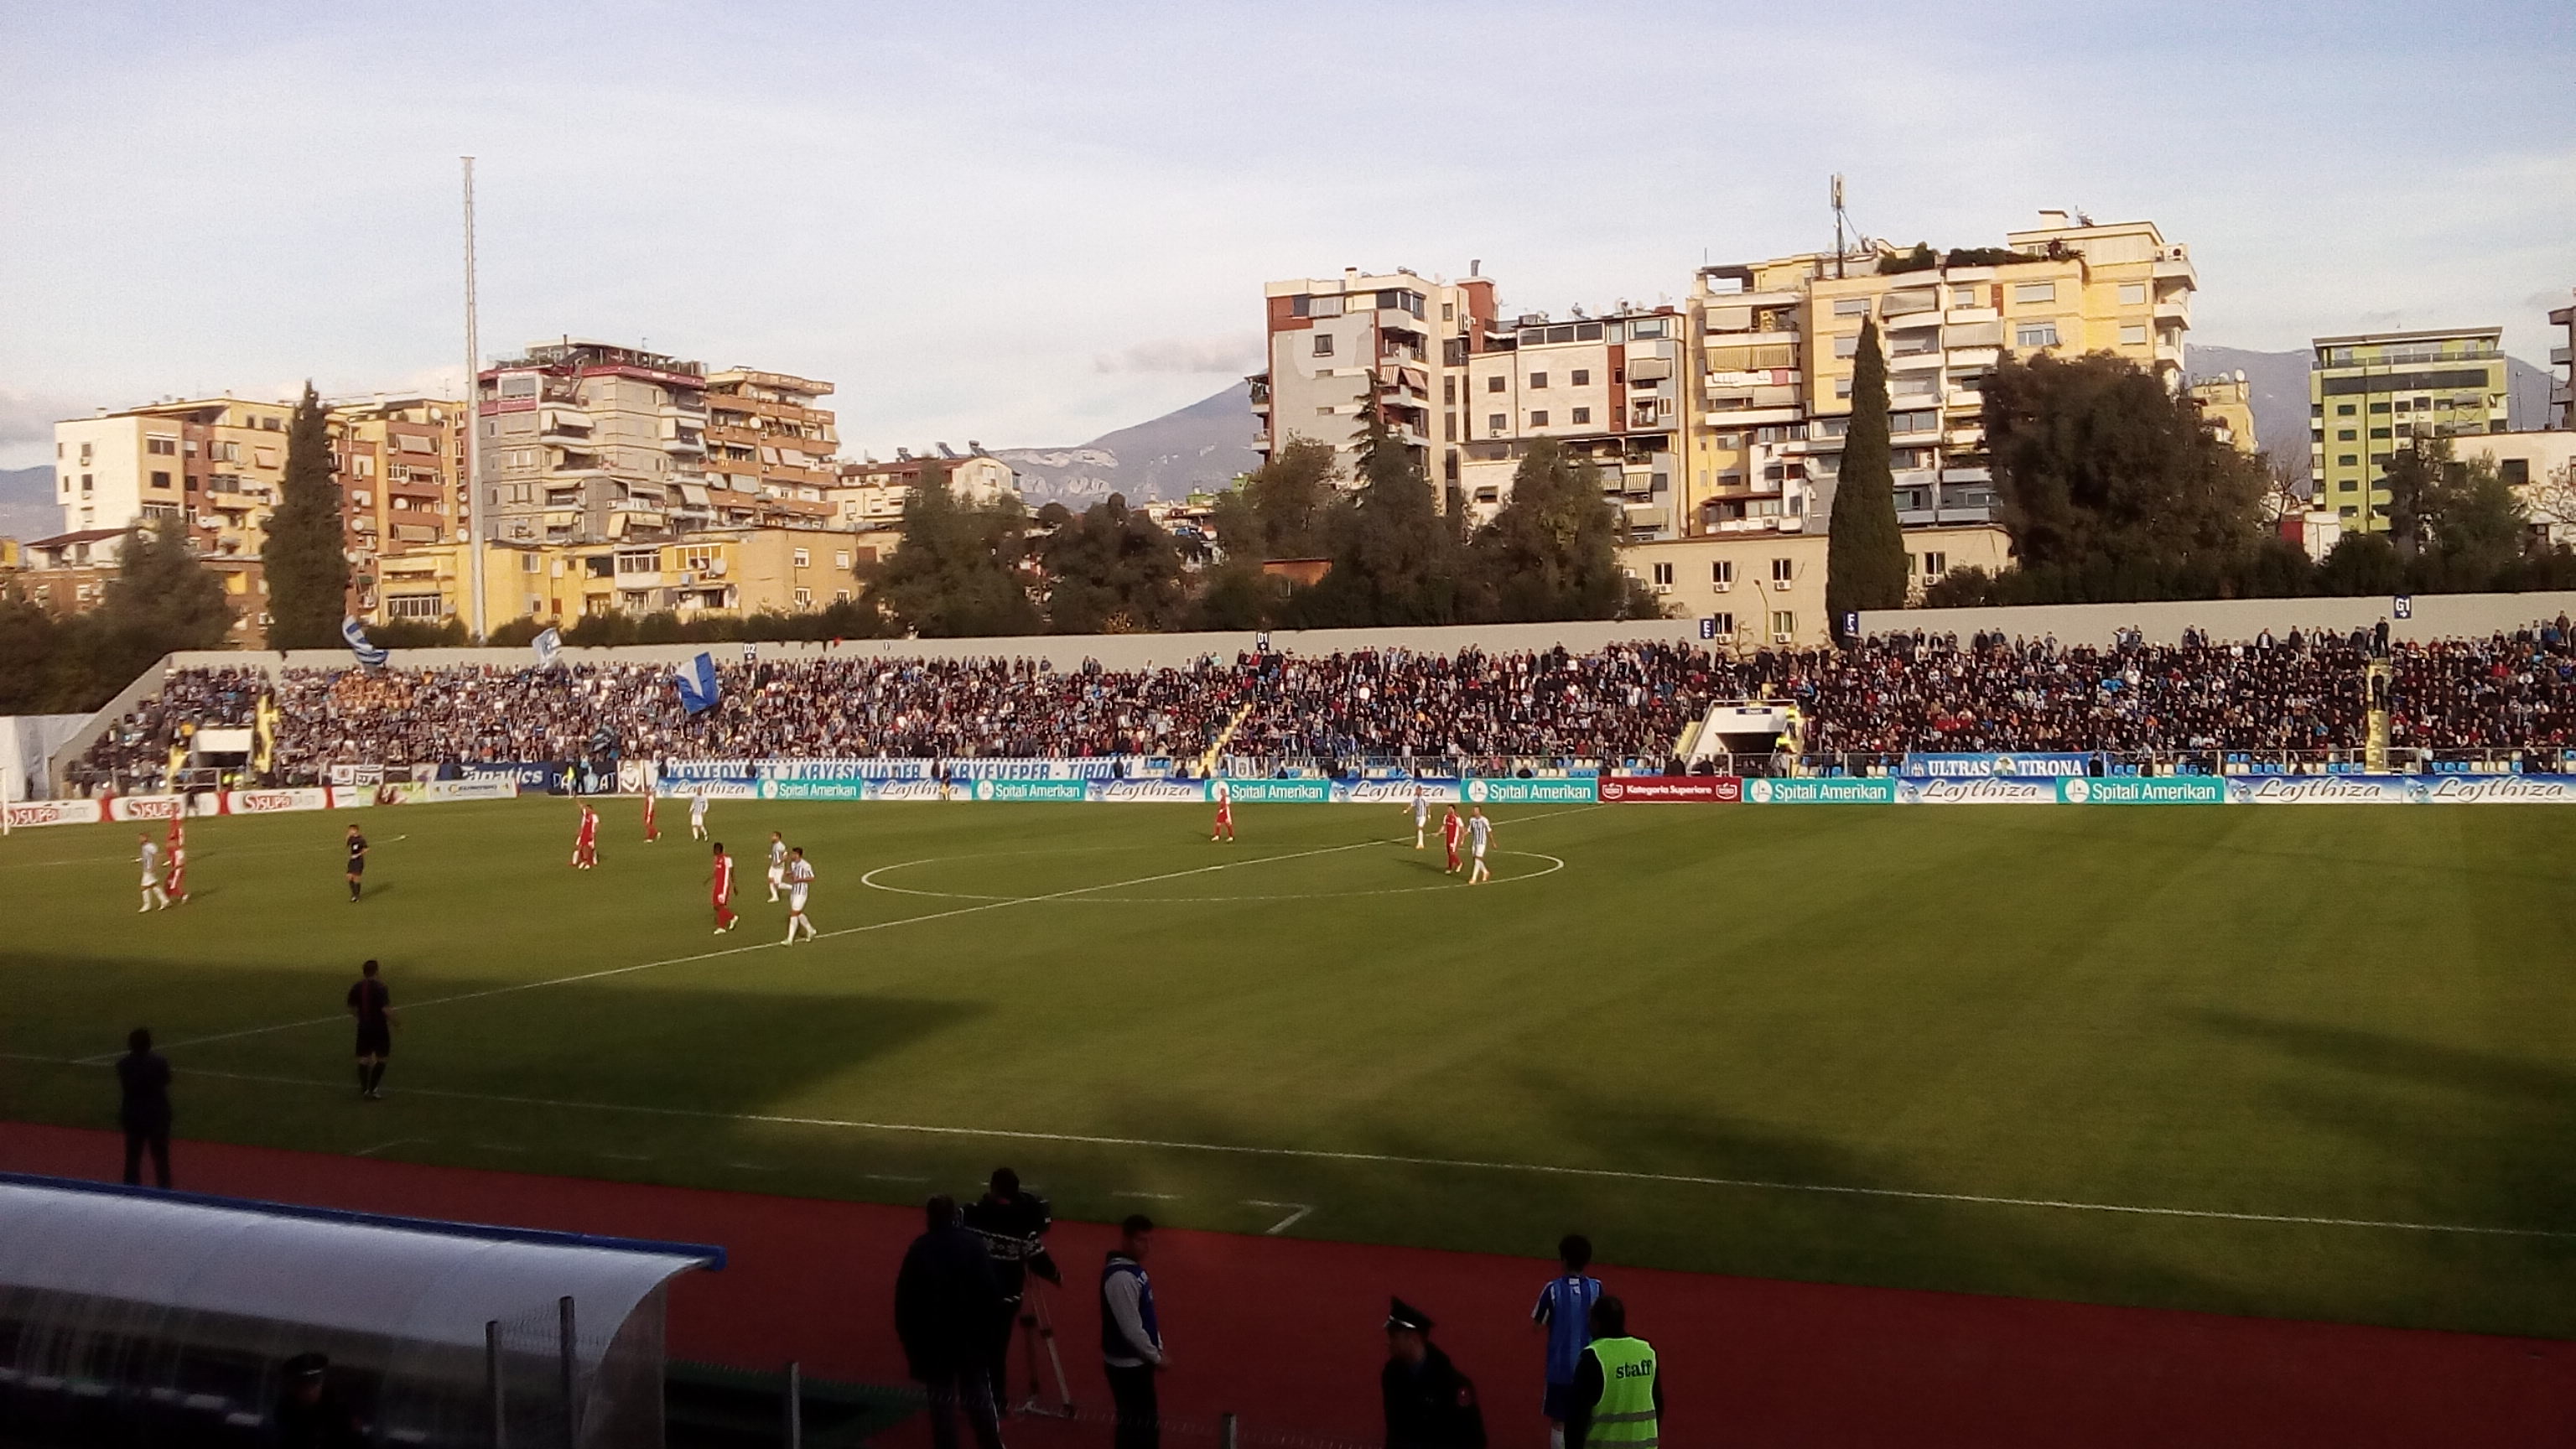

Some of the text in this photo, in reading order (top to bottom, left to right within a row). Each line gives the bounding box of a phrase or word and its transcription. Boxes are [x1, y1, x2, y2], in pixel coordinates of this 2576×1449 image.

[2396, 598, 2410, 611] G1
[1704, 621, 1711, 632] E
[1847, 613, 1855, 626] F
[1258, 632, 1268, 643] D1
[744, 643, 756, 654] D2
[1068, 761, 1133, 779] TIROA
[1928, 760, 2082, 776] ULTRAS TIRONA
[673, 779, 745, 795] Lathiza
[779, 783, 857, 797] Spitali Amerikan
[880, 779, 958, 798] Lajthia
[995, 783, 1080, 798] Spitali Amerikan
[1106, 779, 1190, 799] Lajthiza
[1231, 783, 1322, 800] Spitali Amerikan
[1351, 780, 1445, 801] Lajthza
[1489, 783, 1591, 800] Spitali Amerikan
[1627, 785, 1669, 795] Kategoria
[1670, 785, 1711, 796] Superiore
[1775, 782, 1887, 801] Spitali Amerikan
[1922, 779, 2037, 802] Lajthiza
[2092, 782, 2215, 801] Spitali Amerikan
[2255, 777, 2380, 802] Lajthiza
[2433, 776, 2563, 802] Lajthiza
[1615, 1359, 1653, 1379] staff
